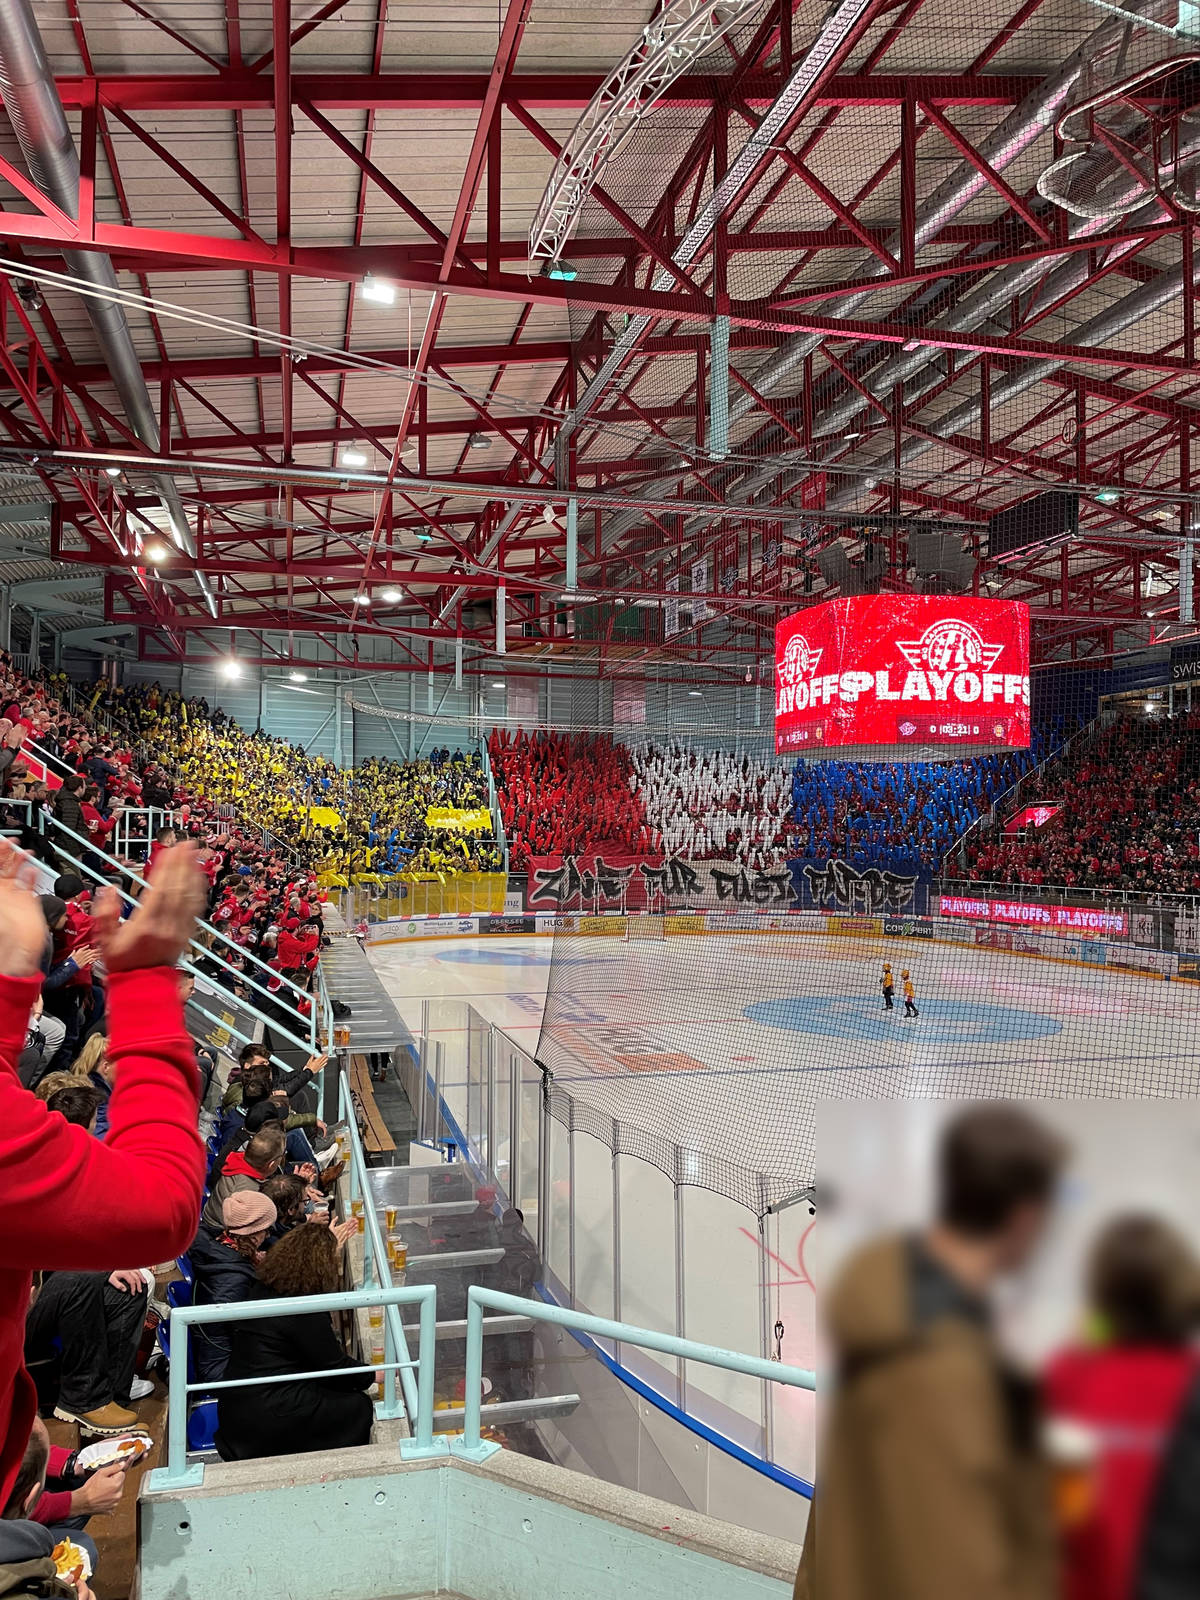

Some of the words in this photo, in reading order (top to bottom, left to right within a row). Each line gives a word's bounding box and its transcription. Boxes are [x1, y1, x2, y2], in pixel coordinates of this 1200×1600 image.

[847, 671, 1030, 707] PLAYOFFS
[543, 919, 563, 927] HUG
[941, 898, 989, 916] PLAYOFFS
[994, 903, 1051, 922] PLAYOFFS
[1057, 910, 1123, 931] PLAYOFFS
